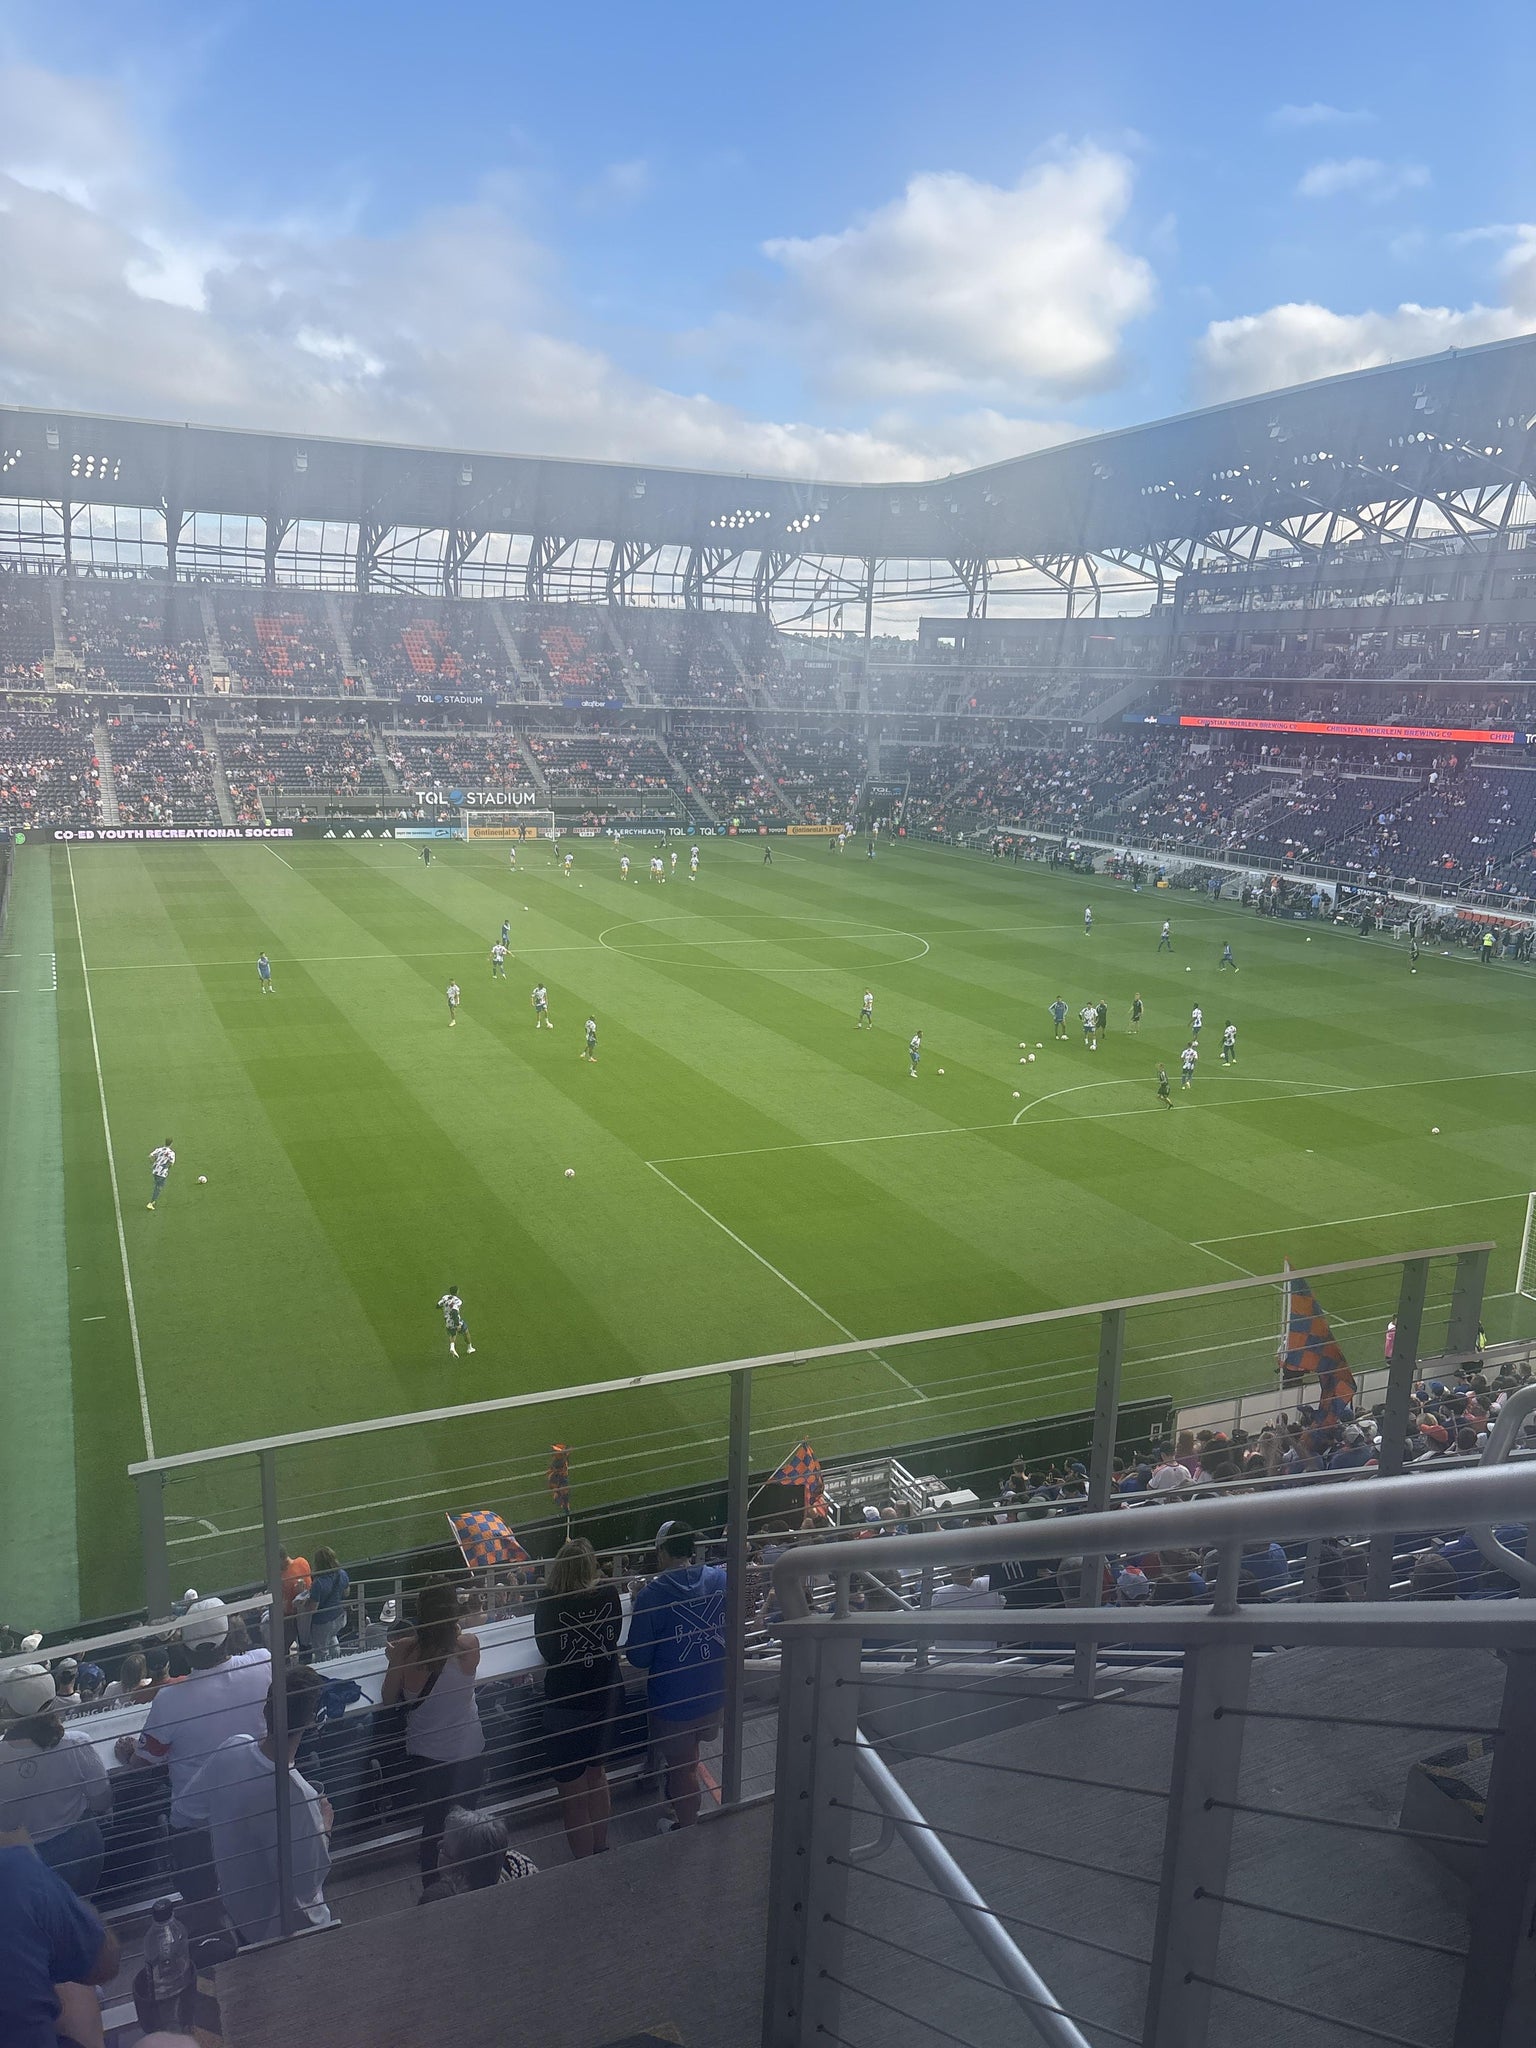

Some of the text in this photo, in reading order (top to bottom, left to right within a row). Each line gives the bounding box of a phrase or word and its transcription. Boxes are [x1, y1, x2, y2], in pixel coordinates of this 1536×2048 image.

[415, 694, 483, 704] TQL STADIUM
[1259, 722, 1288, 730] BREWING
[1326, 725, 1363, 734] CHRISTIAN
[1365, 727, 1401, 736] MOERLEIN
[1404, 729, 1439, 738] BREWING
[415, 791, 536, 805] TQL STADIUM
[54, 827, 294, 840] CO-ED YOUTH RECREATIONAL SOCCER
[473, 828, 511, 837] Continental
[668, 827, 686, 836] TQL
[700, 827, 717, 836] TQL
[792, 826, 824, 834] Continental
